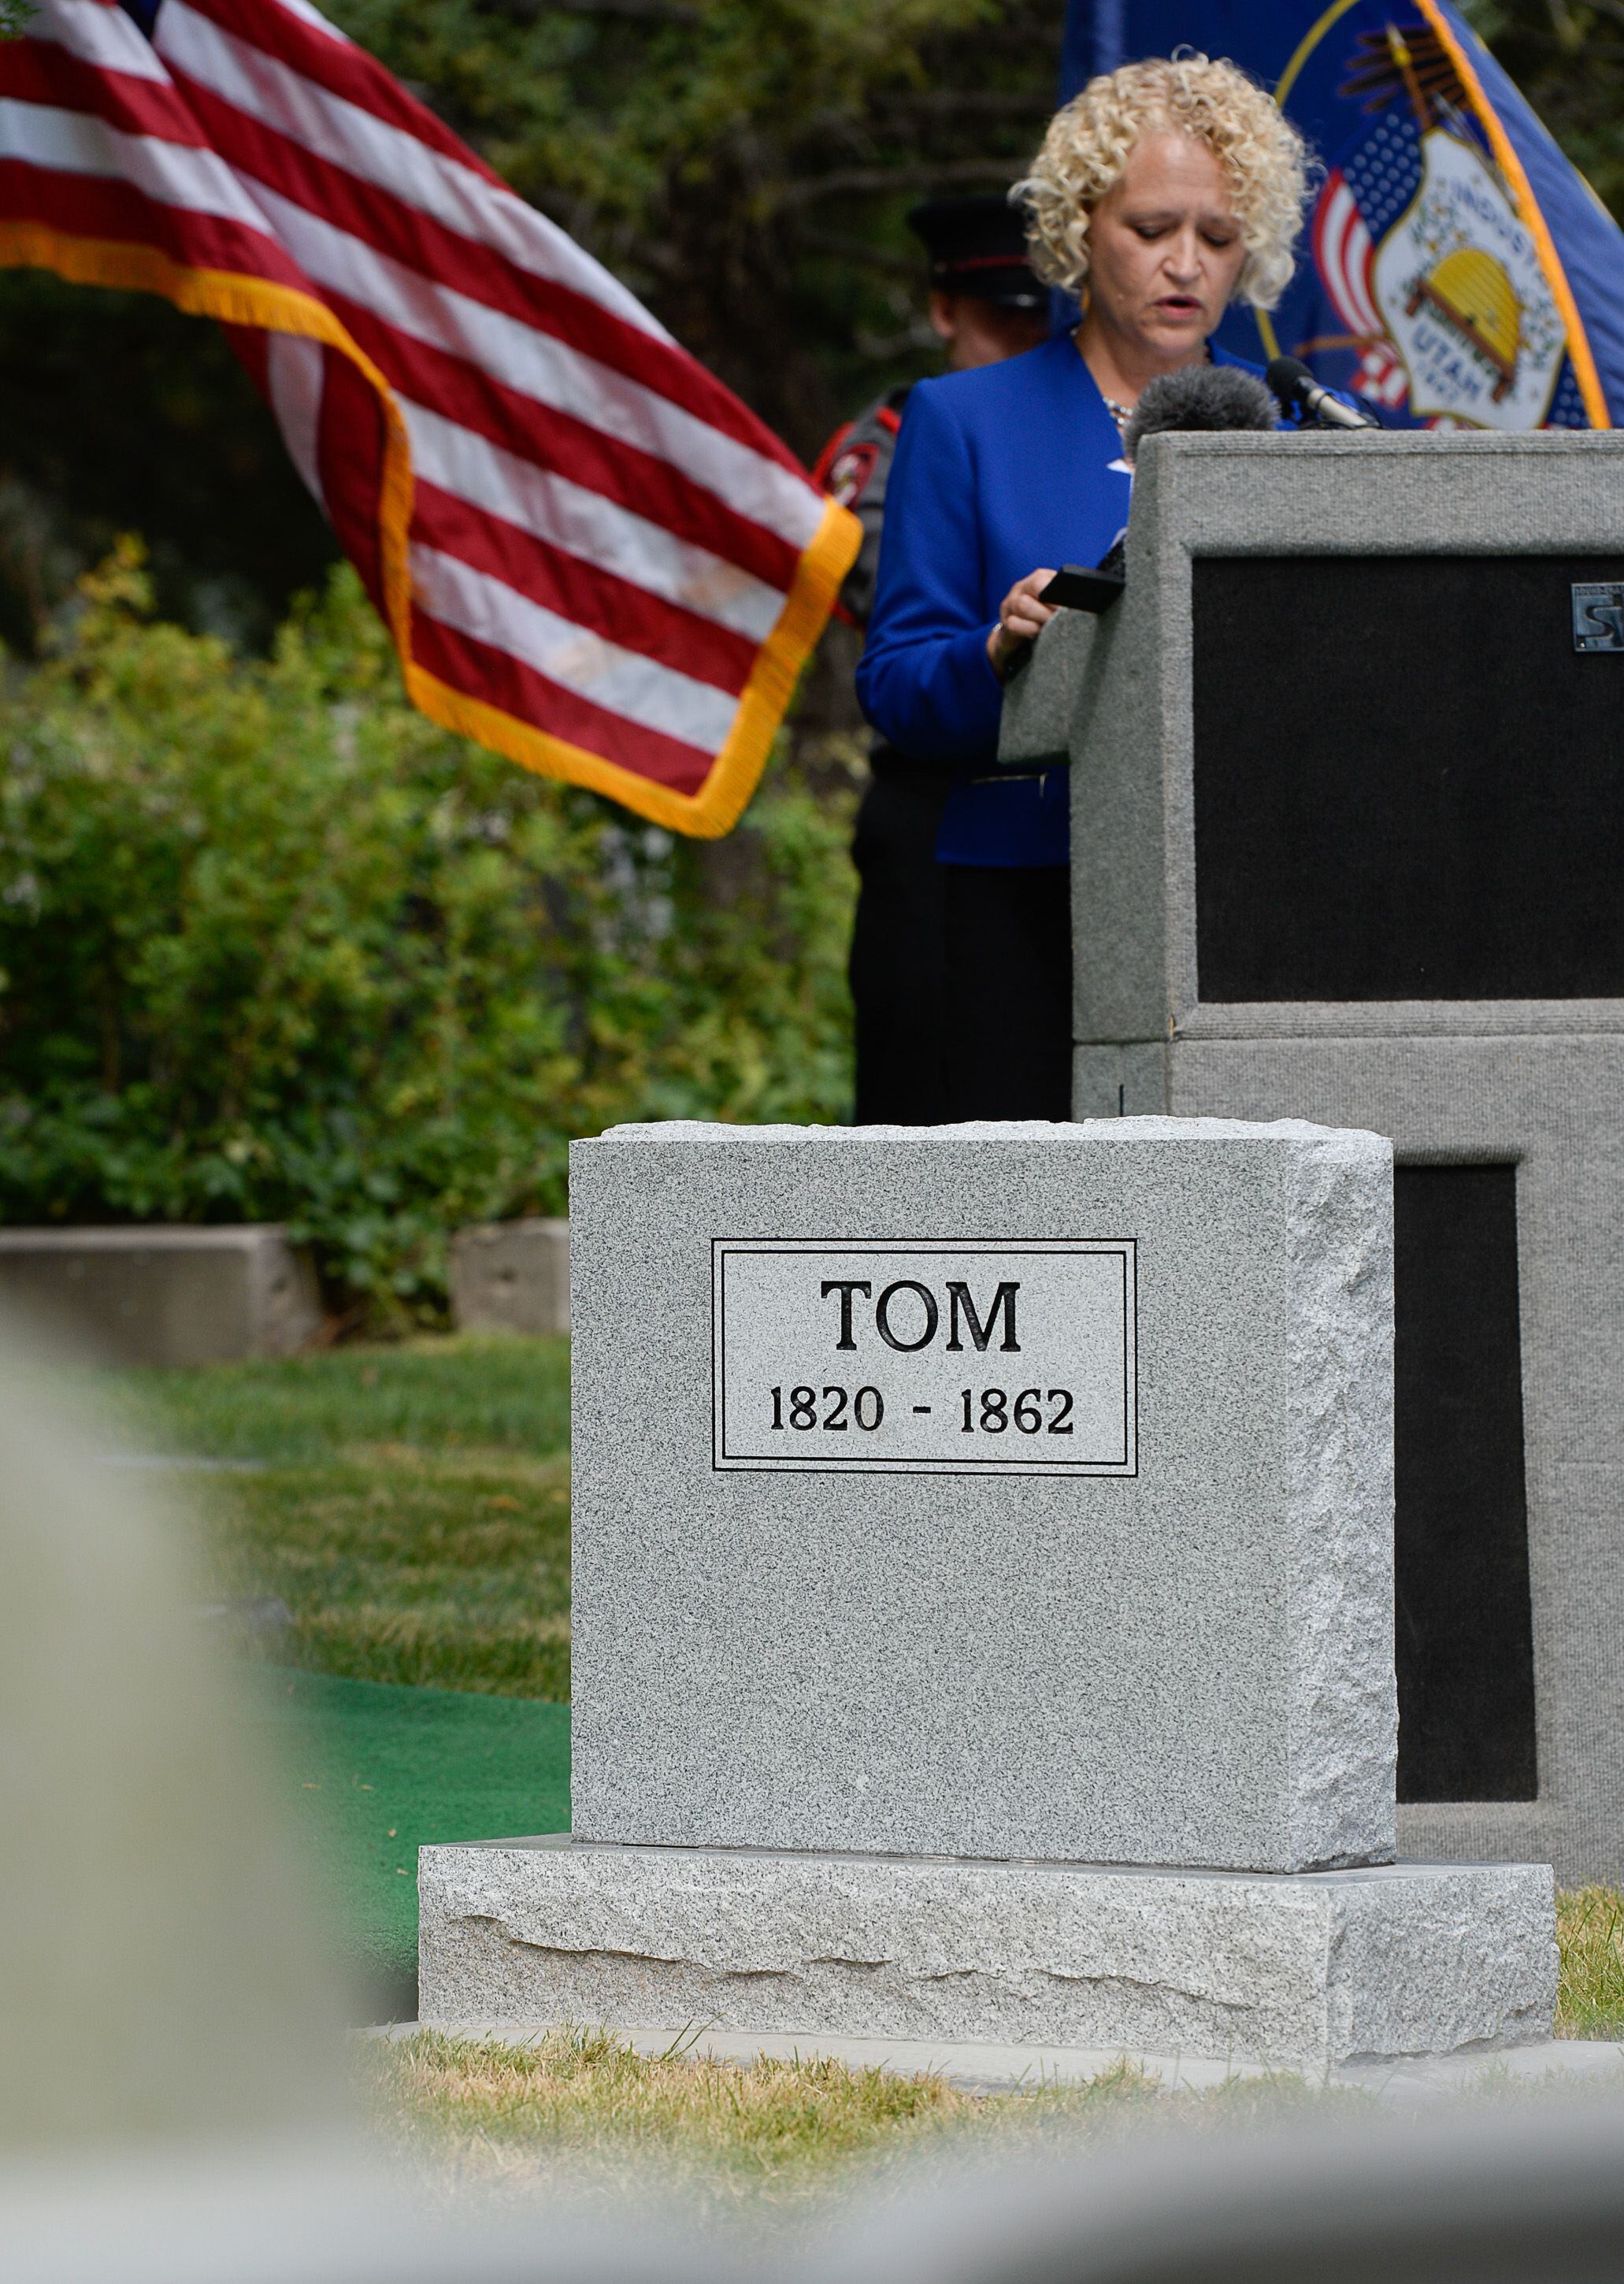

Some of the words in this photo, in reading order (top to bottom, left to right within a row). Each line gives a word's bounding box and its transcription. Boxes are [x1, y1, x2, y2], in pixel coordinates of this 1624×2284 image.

[1412, 322, 1482, 401] UTAH
[821, 1280, 1021, 1352] TOM
[770, 1385, 884, 1431] 1820
[961, 1388, 1073, 1434] 1862
